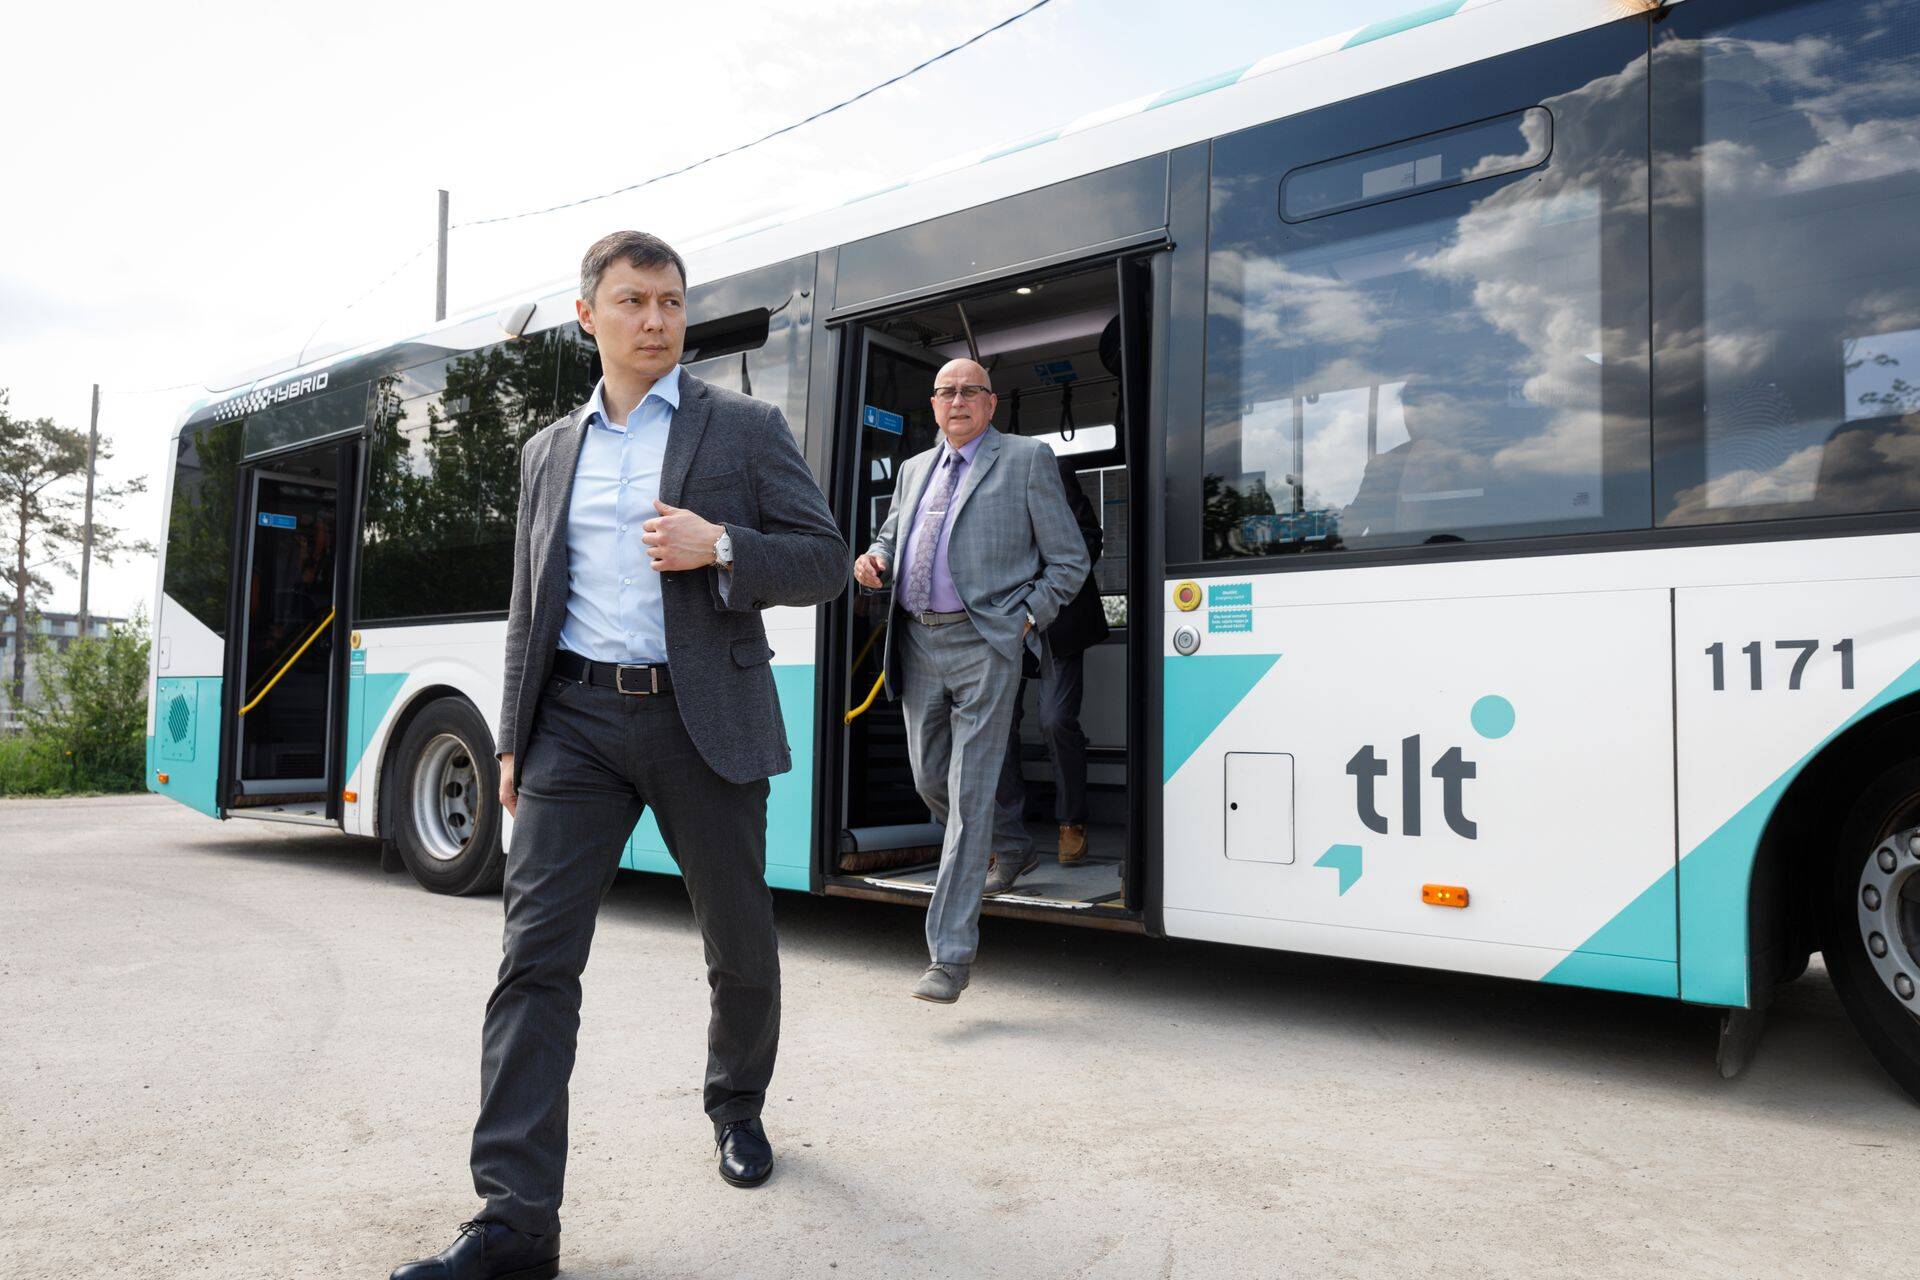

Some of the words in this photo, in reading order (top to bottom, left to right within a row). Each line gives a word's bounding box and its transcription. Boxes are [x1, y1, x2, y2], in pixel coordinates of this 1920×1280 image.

[267, 372, 329, 406] HYBRID
[1704, 638, 1855, 691] 1171
[1345, 733, 1478, 840] tlt
